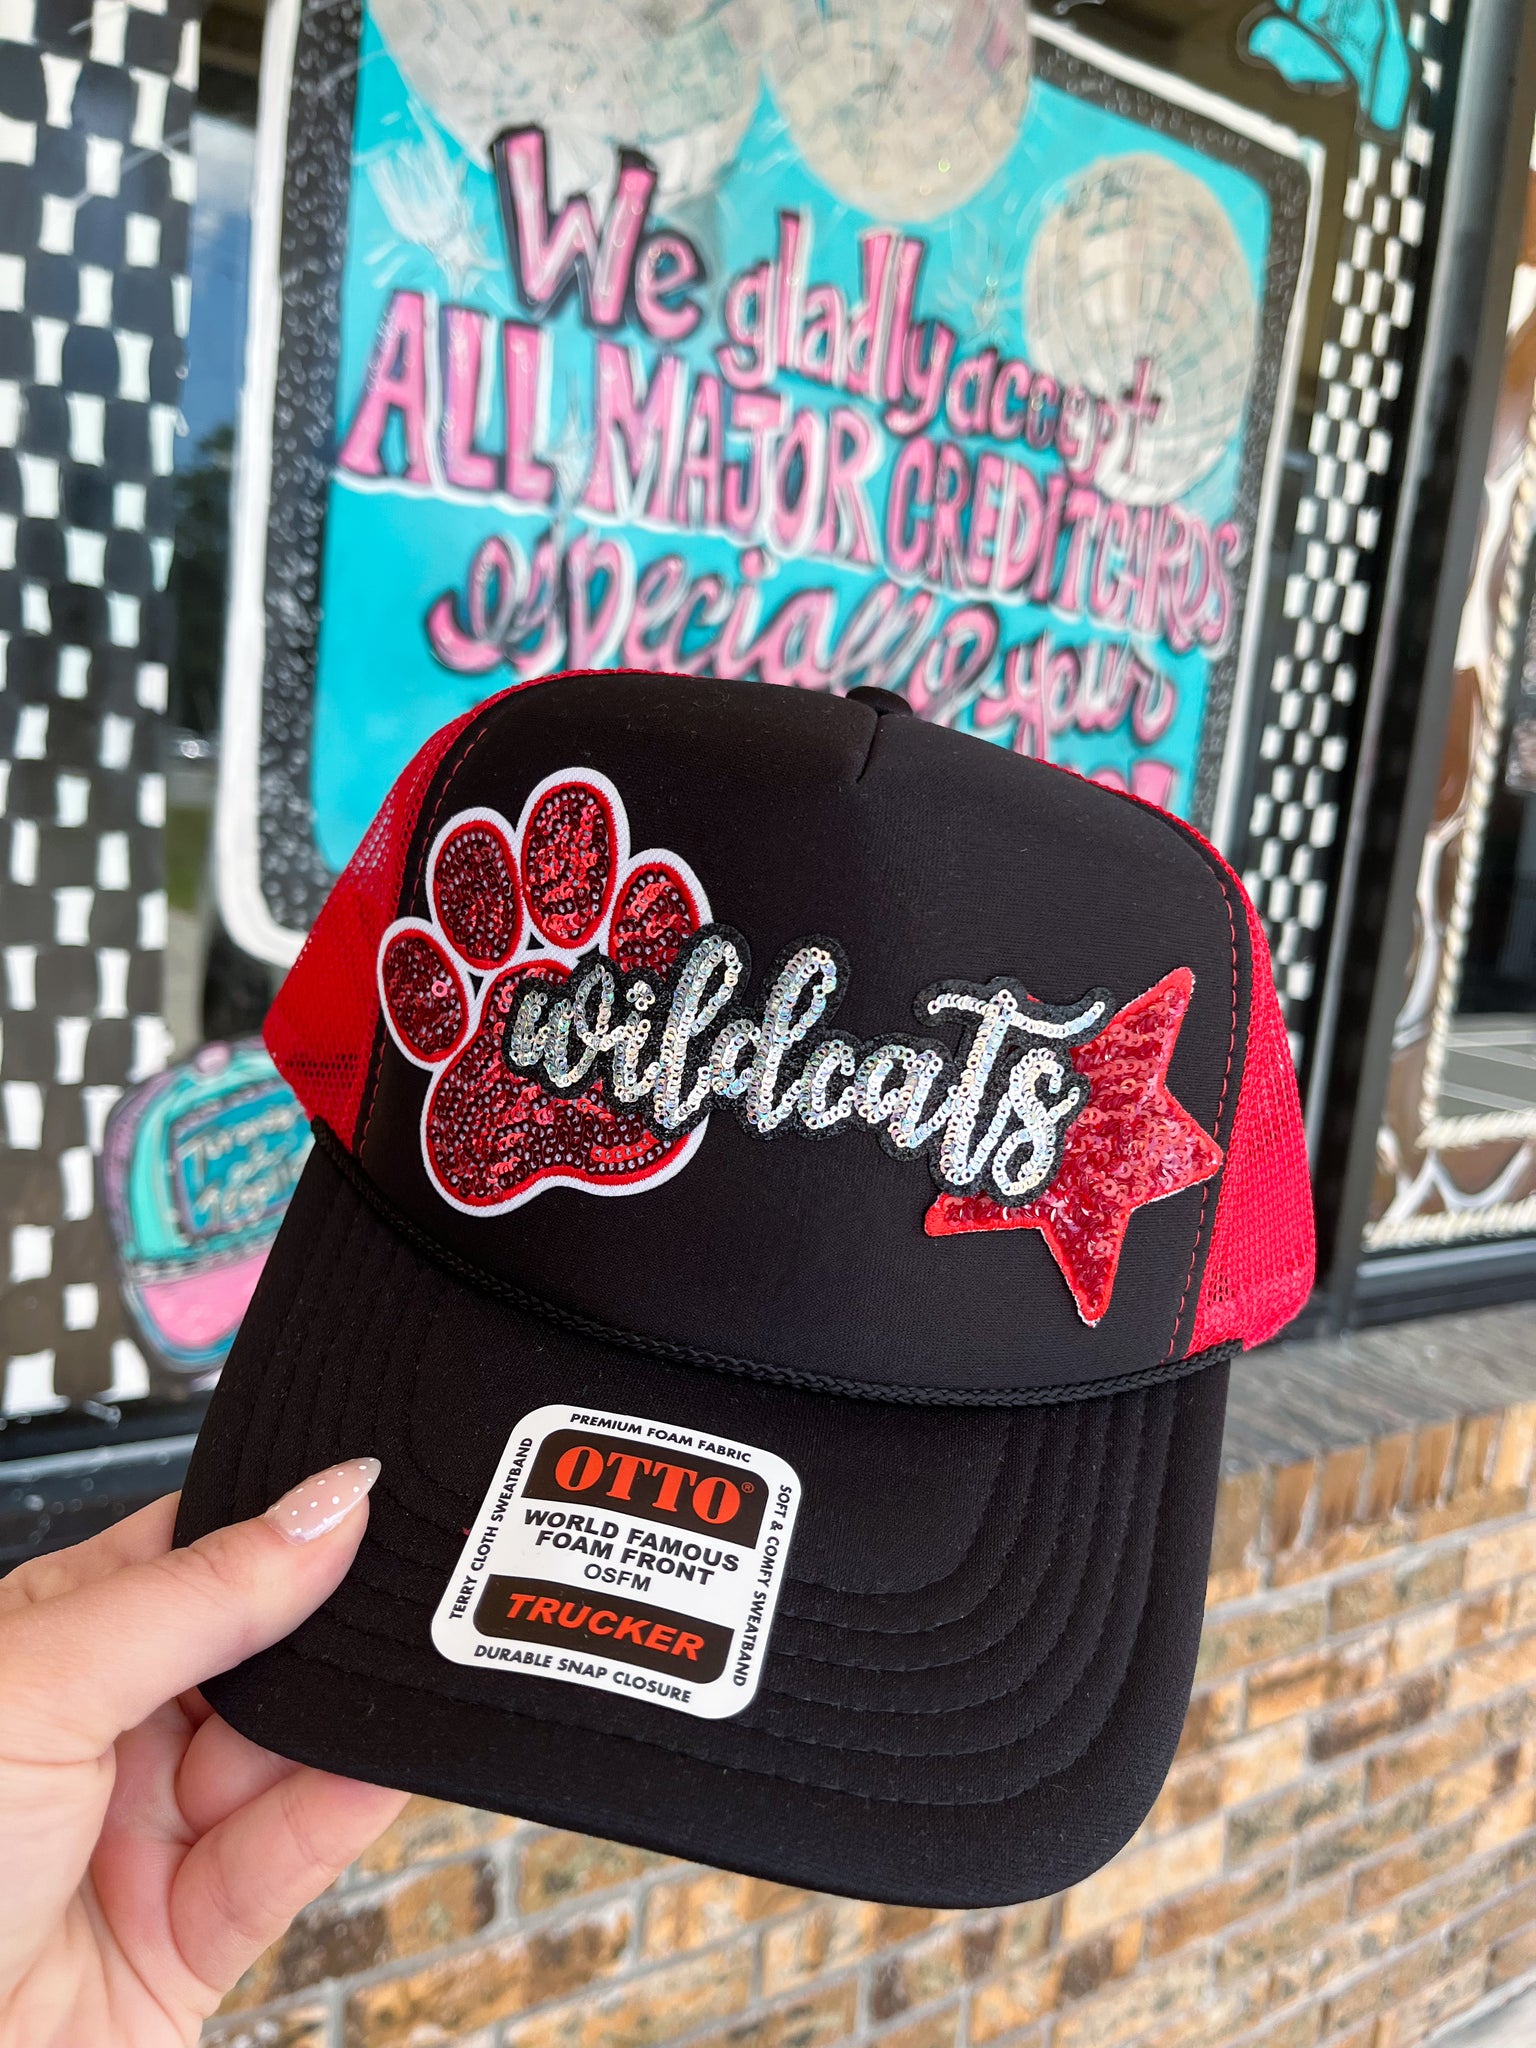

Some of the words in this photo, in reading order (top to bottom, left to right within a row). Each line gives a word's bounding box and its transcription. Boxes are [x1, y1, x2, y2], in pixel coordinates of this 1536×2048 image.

[490, 124, 706, 341] We
[716, 211, 957, 436] gladly
[945, 348, 1161, 486] accept
[337, 289, 556, 504] ALL
[583, 339, 882, 564] MAJOR
[974, 637, 1177, 760] your
[506, 933, 1107, 1196] wildcats
[569, 1412, 643, 1436] PREMIUM
[647, 1426, 693, 1448] FOAM
[697, 1439, 752, 1464] FABRIC
[448, 1574, 479, 1620] TERRY
[470, 1525, 500, 1572] CLOTH
[490, 1437, 534, 1523] SWEATBAND
[769, 1519, 784, 1531] &
[774, 1484, 793, 1519] SOFT
[523, 1508, 620, 1539] WORLD
[626, 1527, 740, 1573] FAMOUS
[534, 1529, 614, 1561] FOAM
[619, 1547, 716, 1586] FRONT
[757, 1535, 781, 1588] COMFY
[583, 1562, 652, 1593] OSFM
[505, 1592, 706, 1662] TRUCKER
[732, 1590, 768, 1688] SWEATBAND
[473, 1643, 552, 1669] DURABLE
[556, 1658, 608, 1681] SNAP
[612, 1670, 692, 1704] CLOSURE
